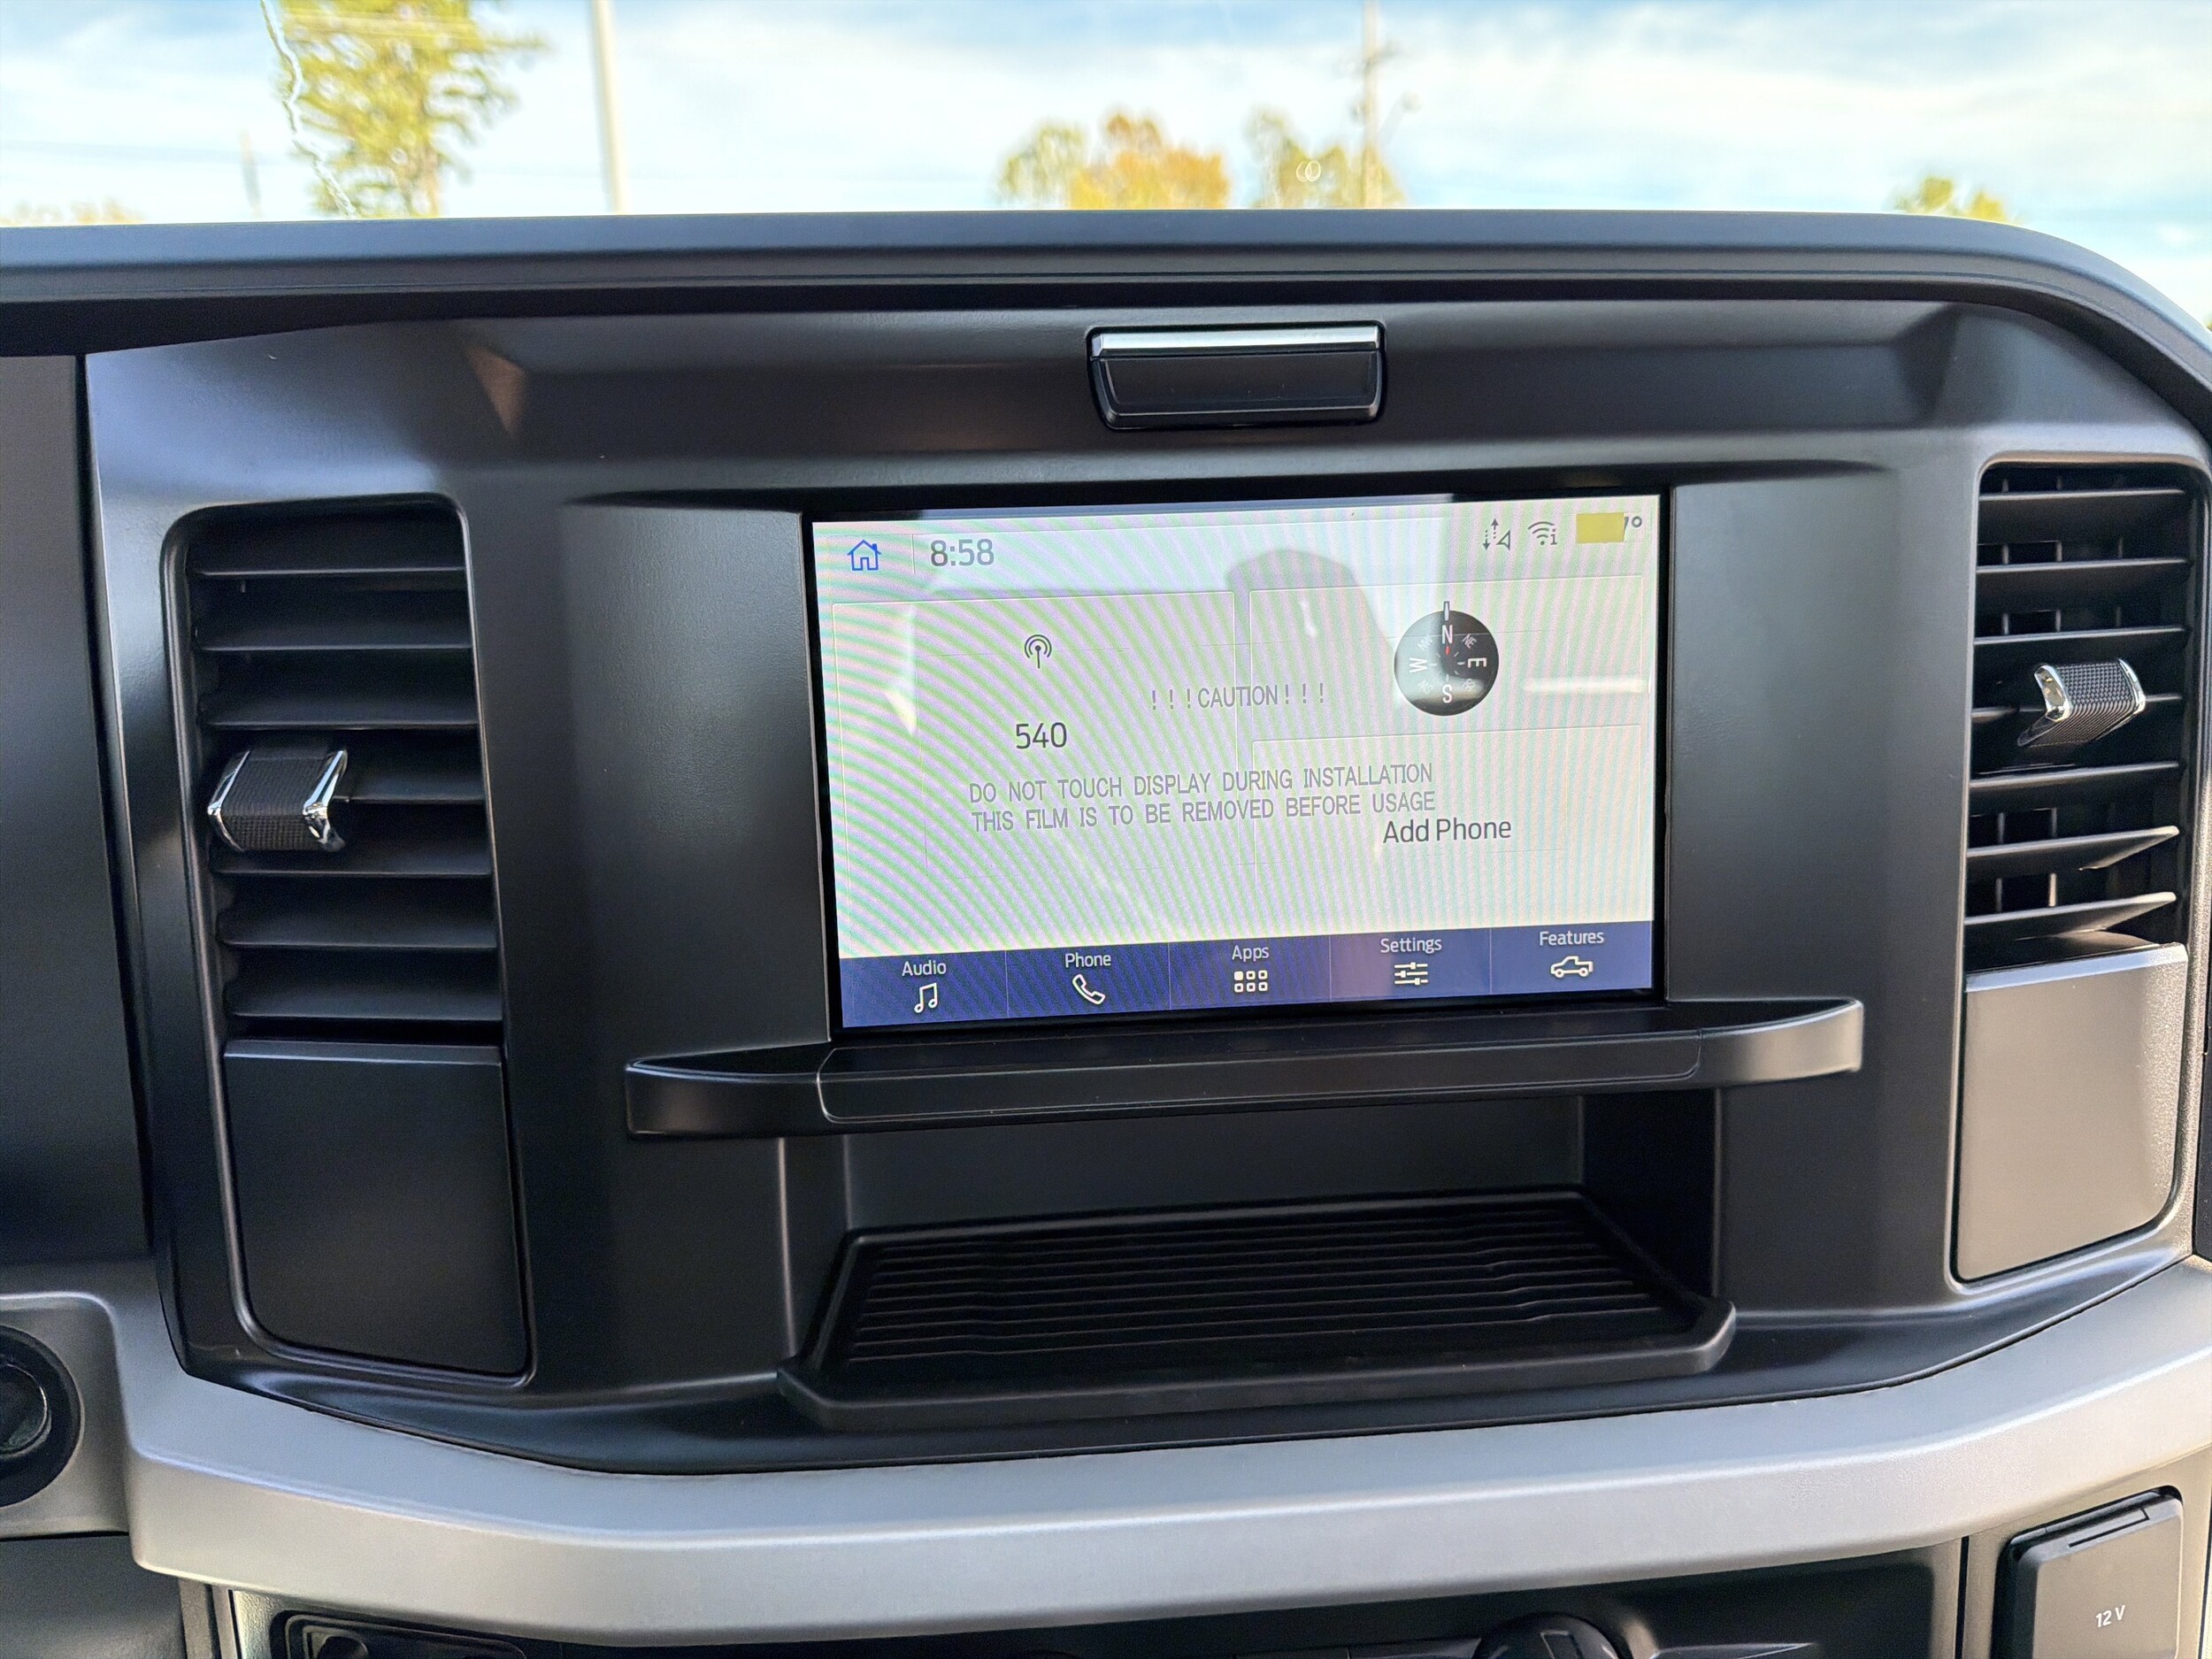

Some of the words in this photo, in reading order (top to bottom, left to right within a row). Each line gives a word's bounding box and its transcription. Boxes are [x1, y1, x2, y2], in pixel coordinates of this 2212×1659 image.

[929, 537, 995, 568] 8:58
[1441, 624, 1454, 645] N
[1409, 657, 1428, 673] W
[1467, 657, 1487, 668] E
[1441, 684, 1453, 704] S
[1014, 721, 1069, 750] 540
[969, 782, 997, 803] DO
[1009, 780, 1048, 802] NOT
[1057, 776, 1123, 799] TOUCH
[1133, 772, 1211, 796] DISPLAY
[1223, 769, 1293, 792] DURING
[1303, 763, 1432, 789] INSTALLATION
[971, 810, 1014, 833] THIS
[1025, 807, 1069, 830] FILM
[1079, 806, 1098, 828] IS
[1108, 804, 1133, 826] TO
[1145, 803, 1171, 825] BE
[1182, 798, 1274, 823] REMOVED
[1286, 794, 1362, 818] BEFORE
[1372, 790, 1435, 814] USAGE
[1382, 818, 1430, 844] Add
[1436, 817, 1512, 841] Phone
[1379, 936, 1443, 955] Settings
[1539, 930, 1605, 947] Features
[1064, 951, 1112, 969] Phone
[1231, 944, 1270, 962] Apps
[901, 960, 948, 978] Audio
